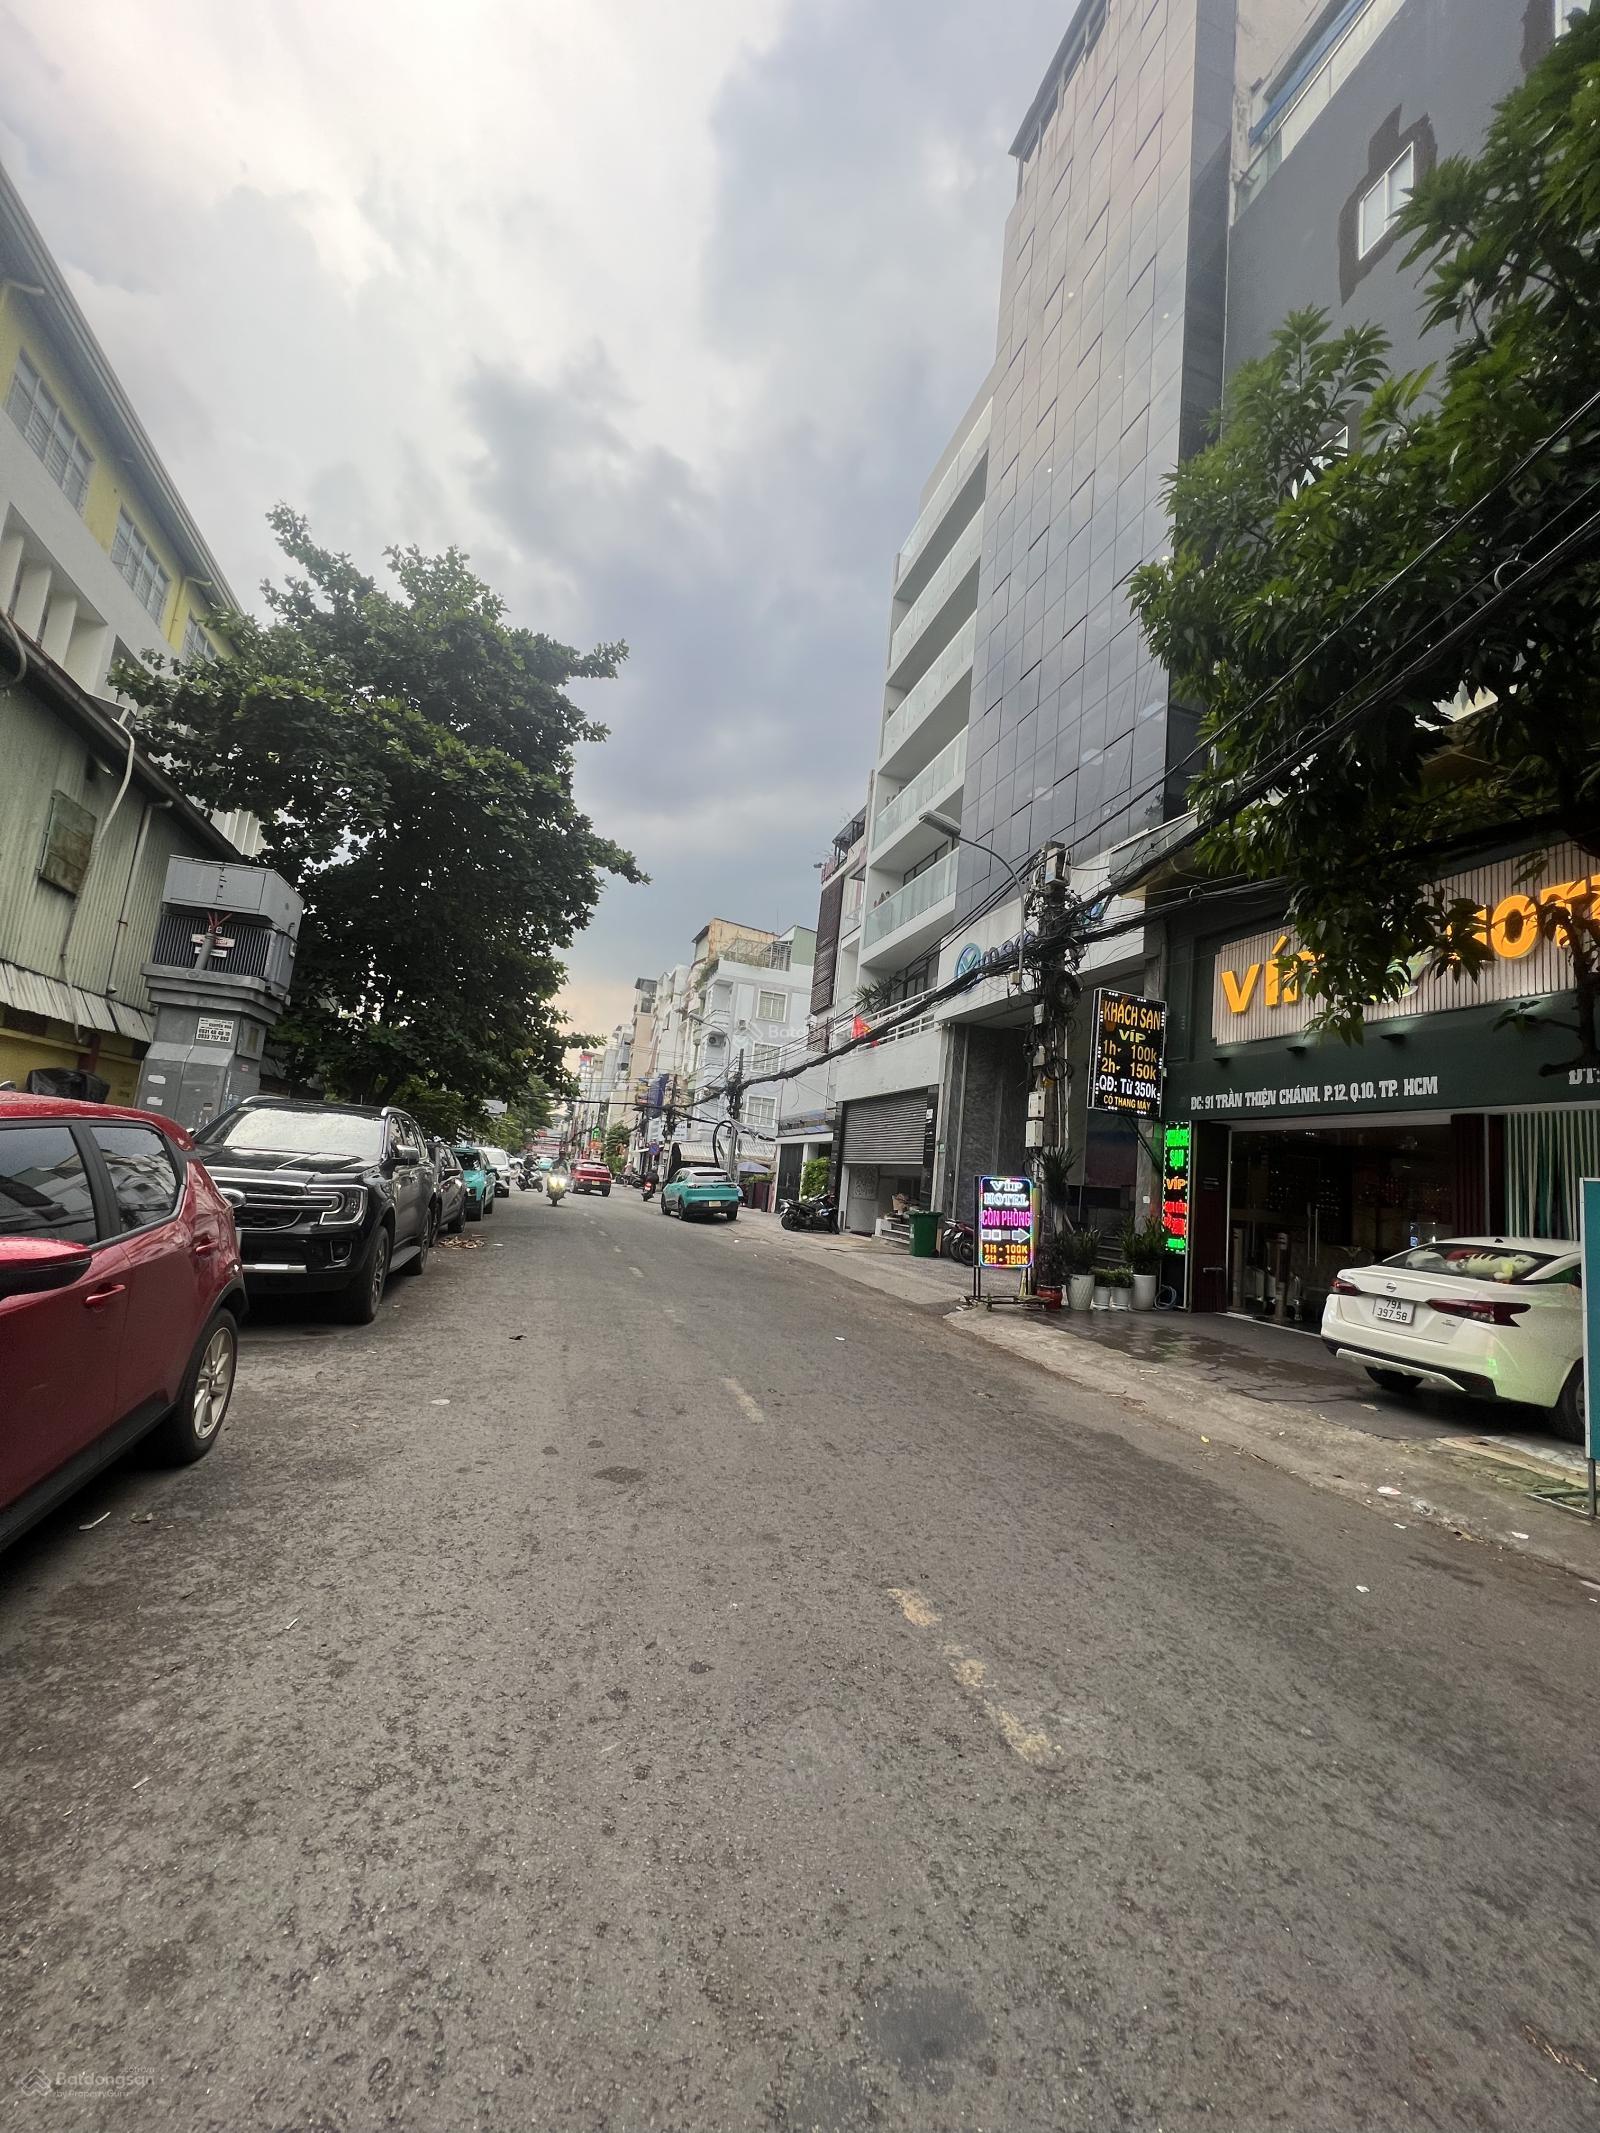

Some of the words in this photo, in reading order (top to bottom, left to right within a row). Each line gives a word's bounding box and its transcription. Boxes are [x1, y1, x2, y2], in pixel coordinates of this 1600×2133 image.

[1103, 999, 1138, 1026] KHÁCH
[1140, 1008, 1161, 1034] SẠN
[1119, 1029, 1147, 1043] VÍP
[1131, 1045, 1157, 1063] 100k
[1130, 1063, 1156, 1080] 150k
[1099, 1075, 1118, 1092] QĐ:
[1120, 1078, 1133, 1095] Từ
[1134, 1082, 1157, 1099] 350k
[1190, 1096, 1204, 1110] ĐC:
[1204, 1095, 1214, 1109] 91
[1245, 1088, 1276, 1109] THIỆN
[1379, 1079, 1399, 1098] TP.
[1403, 1076, 1438, 1096] HCM
[1103, 1093, 1113, 1104] CÓ
[1114, 1096, 1136, 1107] THANG
[1137, 1098, 1151, 1110] MÁY
[990, 1180, 1023, 1192] VÍP
[1166, 1176, 1187, 1190] VÍP
[983, 1192, 1029, 1206] HOTEL
[982, 1207, 1000, 1226] CÒN
[1001, 1207, 1030, 1227] PHÒNG
[984, 1244, 997, 1254] 1H
[1005, 1244, 1028, 1254] 100K
[984, 1255, 997, 1264] 2H
[1005, 1255, 1028, 1265] 150K
[1386, 1299, 1402, 1310] 79A
[1377, 1307, 1408, 1321] 397.58
